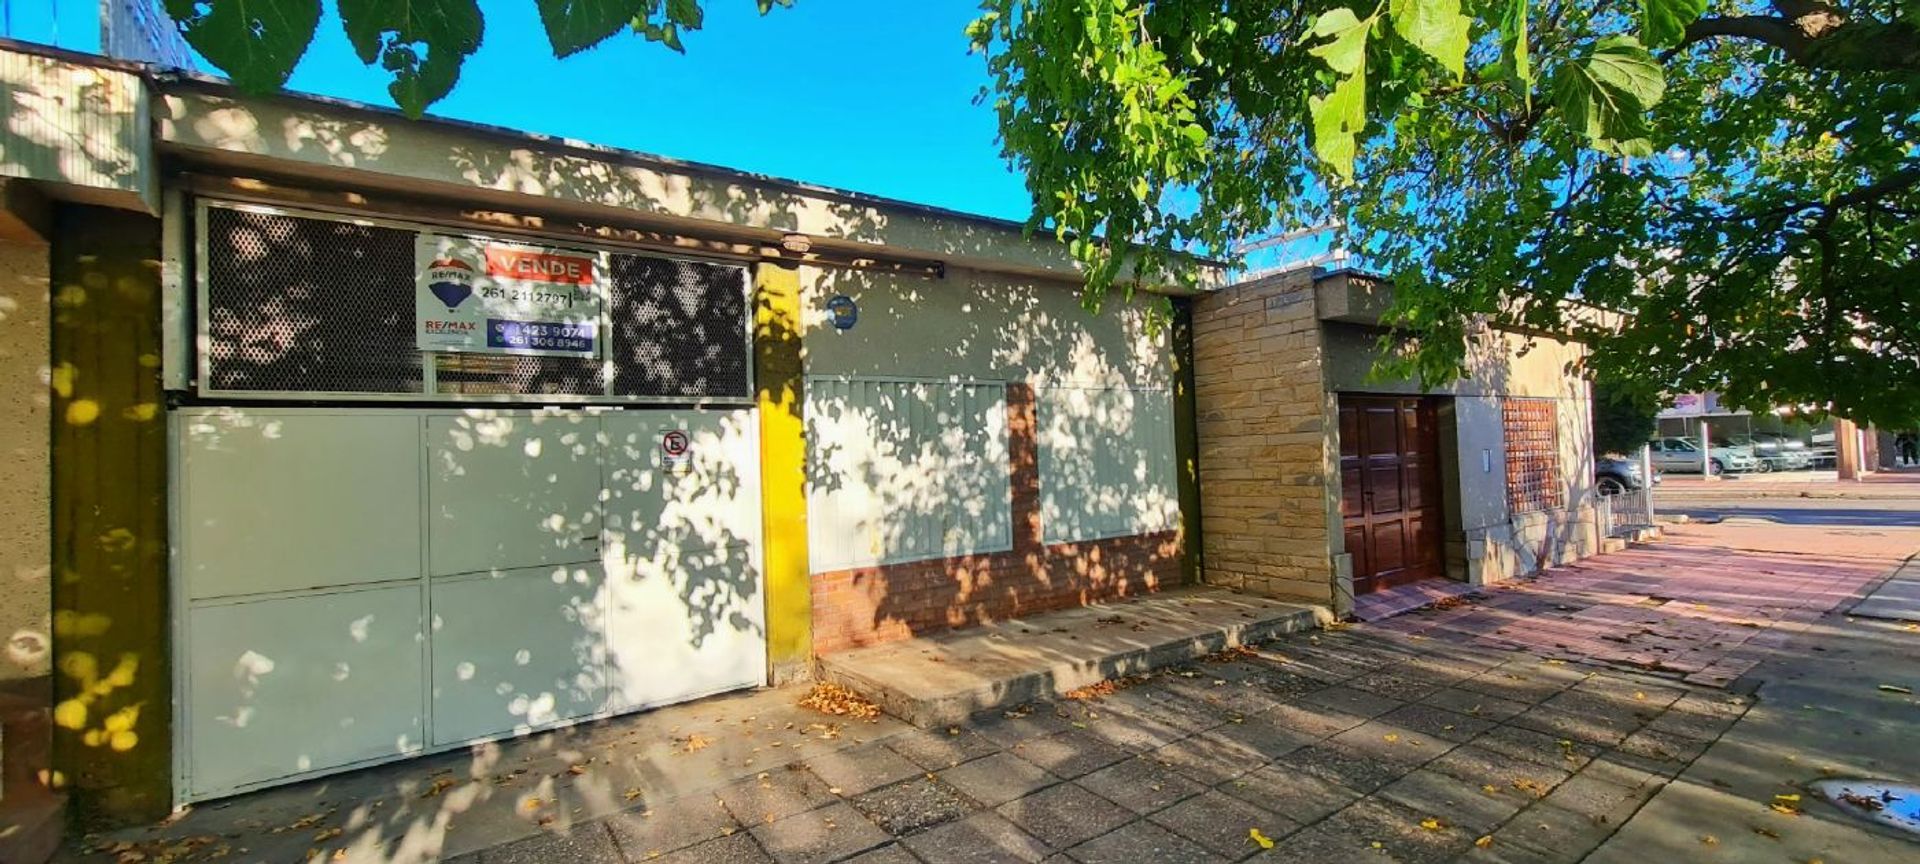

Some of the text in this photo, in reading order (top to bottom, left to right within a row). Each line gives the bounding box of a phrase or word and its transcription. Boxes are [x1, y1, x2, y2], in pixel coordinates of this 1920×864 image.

[500, 256, 581, 278] VENDE
[432, 271, 470, 280] RE/MAX
[482, 287, 505, 299] 261
[426, 320, 476, 330] RE/MAX
[509, 336, 528, 344] 261
